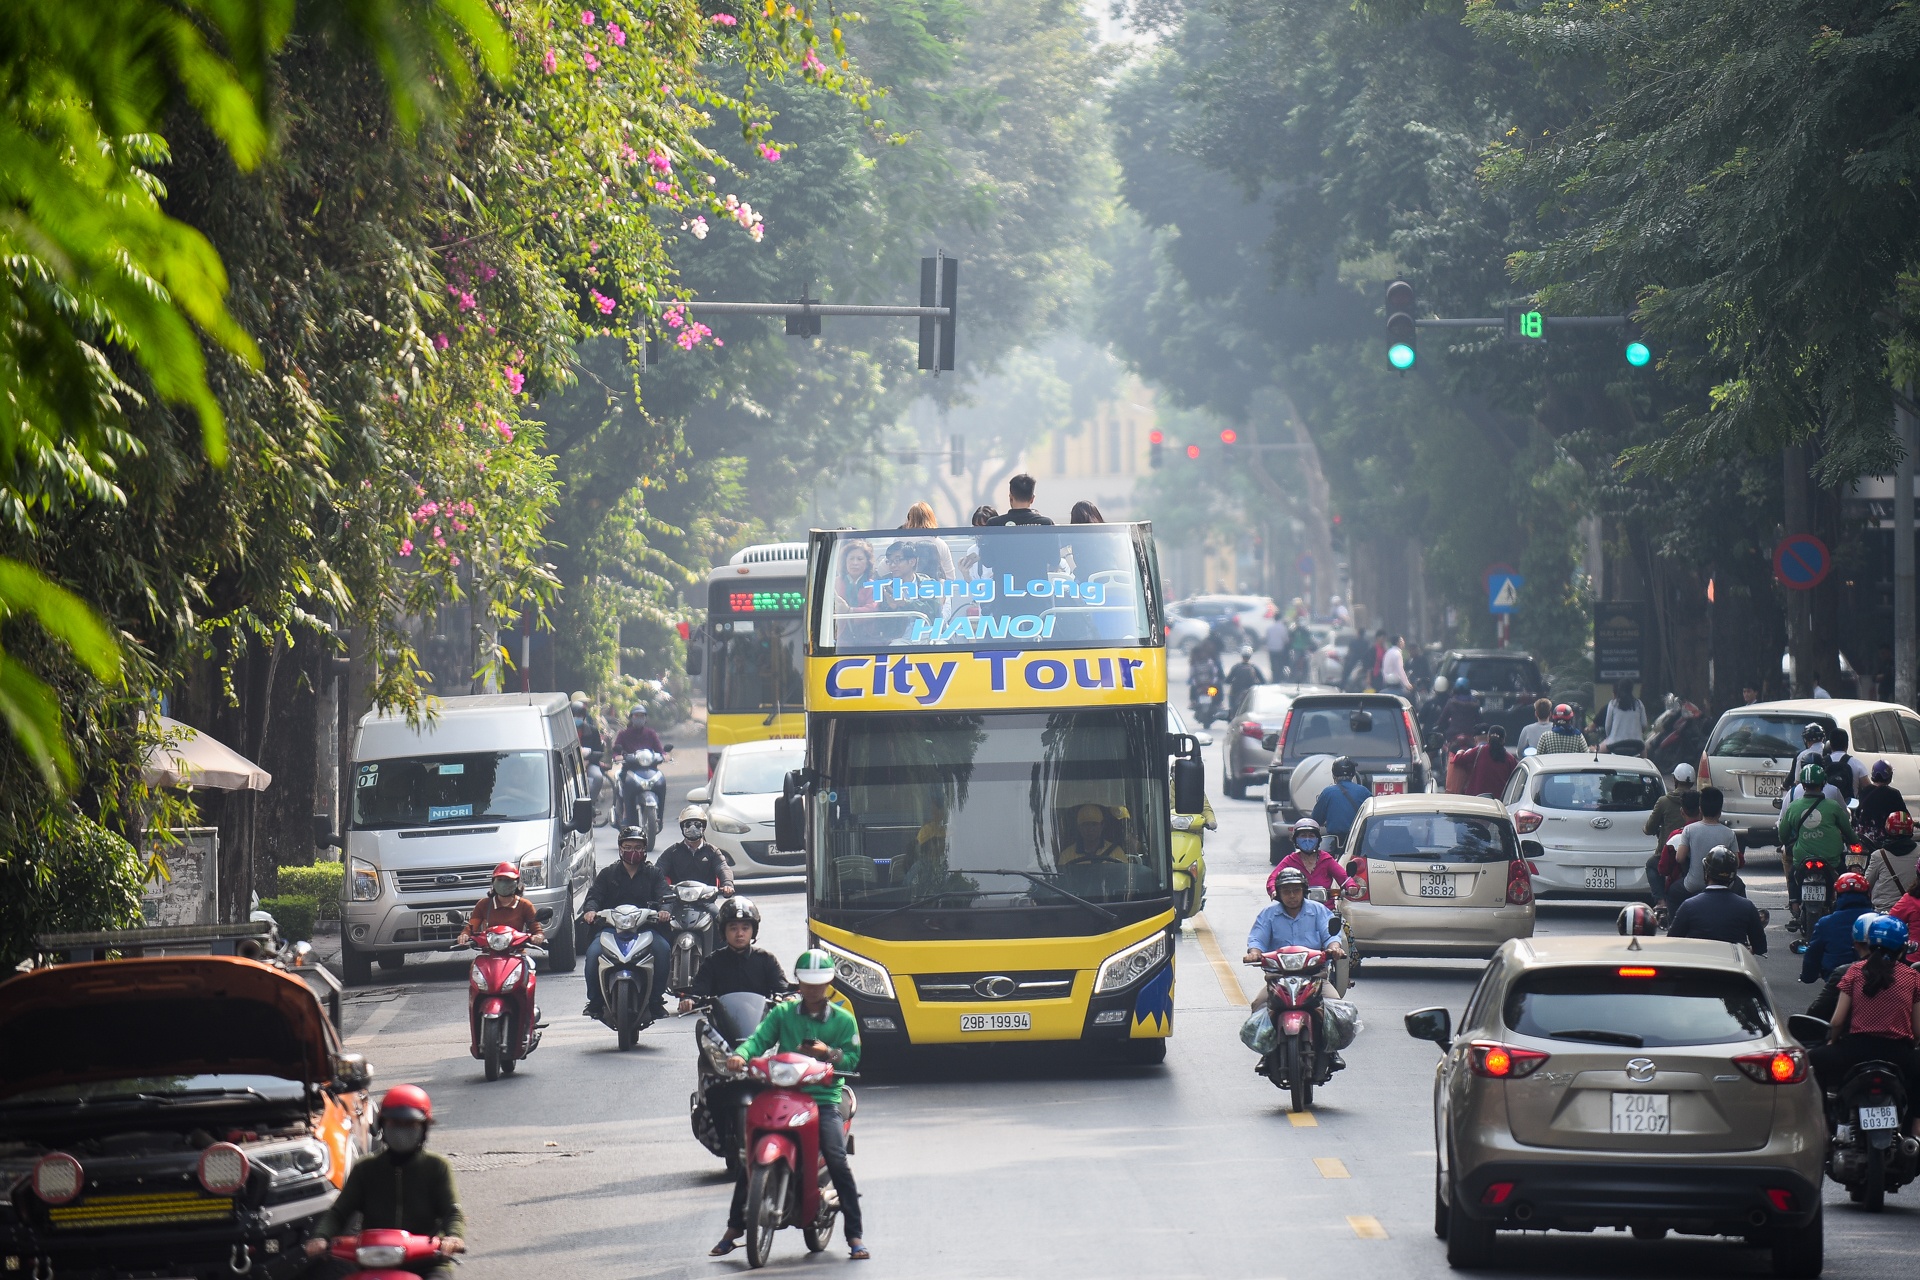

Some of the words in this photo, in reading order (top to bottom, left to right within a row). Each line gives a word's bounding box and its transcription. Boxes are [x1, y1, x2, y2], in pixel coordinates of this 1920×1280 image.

[1521, 312, 1542, 338] 18
[863, 577, 995, 602] Thang
[1003, 573, 1106, 605] Long
[911, 614, 1057, 642] HANOI
[825, 653, 959, 706] City
[973, 650, 1145, 692] Tour
[358, 774, 378, 788] 01
[1761, 777, 1777, 786] 30N
[1758, 786, 1779, 796] 9426
[432, 808, 469, 817] NITORI
[1802, 830, 1824, 839] Grab
[439, 875, 456, 883] Ford
[1592, 868, 1609, 878] 30A
[1428, 874, 1447, 886] 30A
[1585, 878, 1615, 888] 933.85
[1421, 885, 1455, 897] 836.82
[962, 1015, 1029, 1030] 29B-199.94
[1625, 1095, 1656, 1113] 20A
[1865, 1107, 1892, 1118] 14-B6
[1615, 1114, 1669, 1133] 112.07
[1862, 1117, 1896, 1129] 603.73
